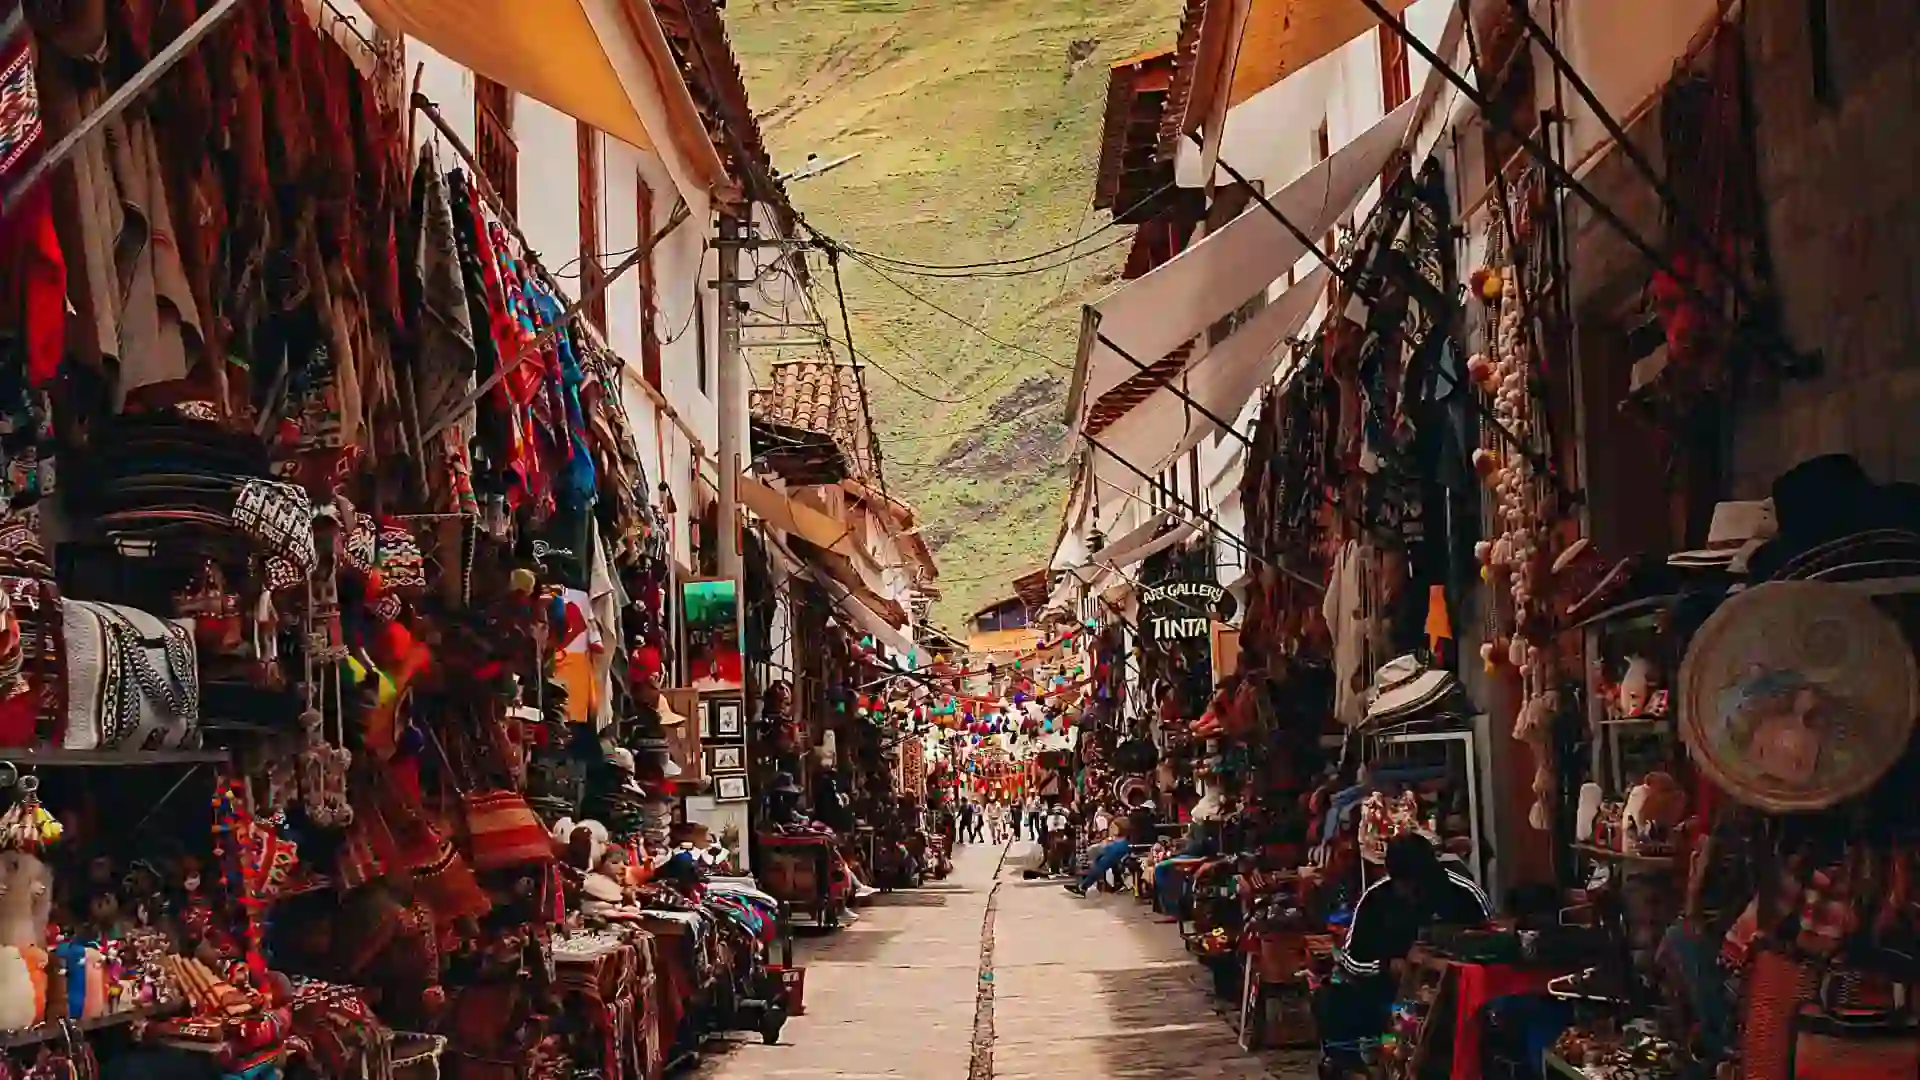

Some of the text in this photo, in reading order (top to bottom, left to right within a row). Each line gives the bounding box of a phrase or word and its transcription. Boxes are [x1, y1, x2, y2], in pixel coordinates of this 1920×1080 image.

[1143, 583, 1224, 605] ART GALLERY
[1151, 616, 1208, 639] TINTA
